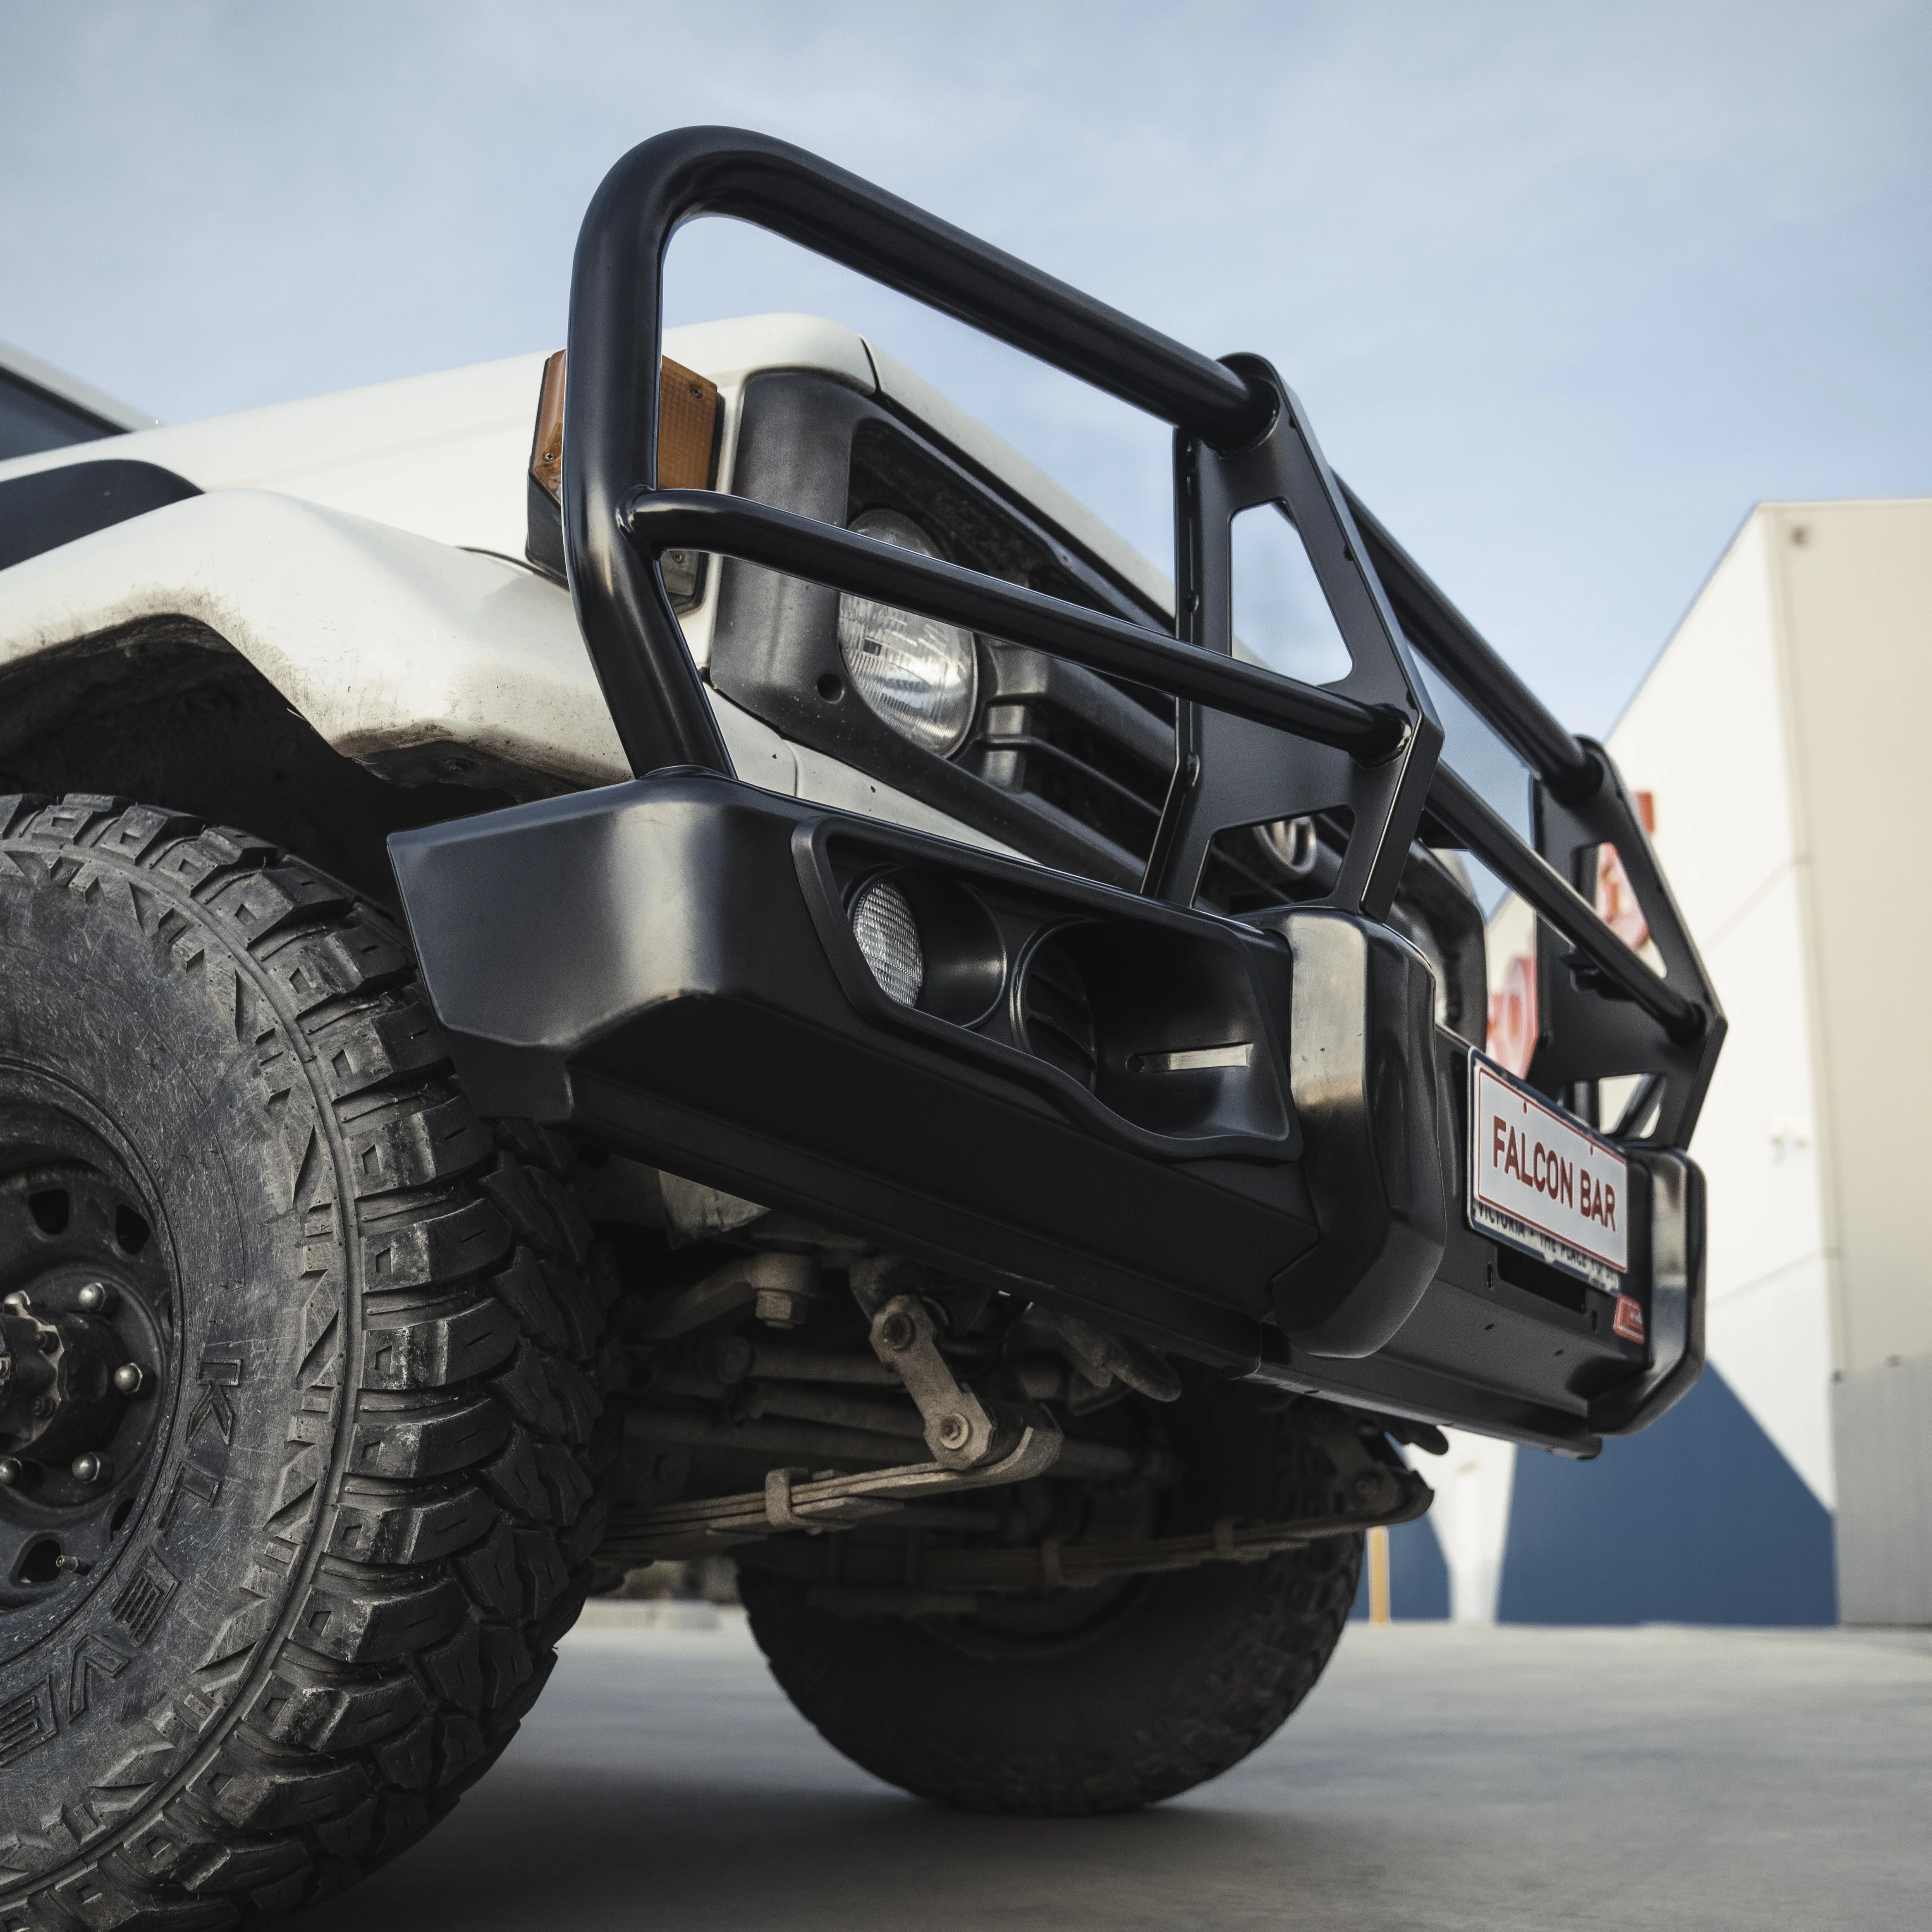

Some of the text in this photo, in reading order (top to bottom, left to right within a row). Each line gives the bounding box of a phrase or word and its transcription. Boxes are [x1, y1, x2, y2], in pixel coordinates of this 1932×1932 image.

[1493, 1115, 1616, 1233] FALCON BAR
[1478, 1201, 1525, 1238] VICTORIA
